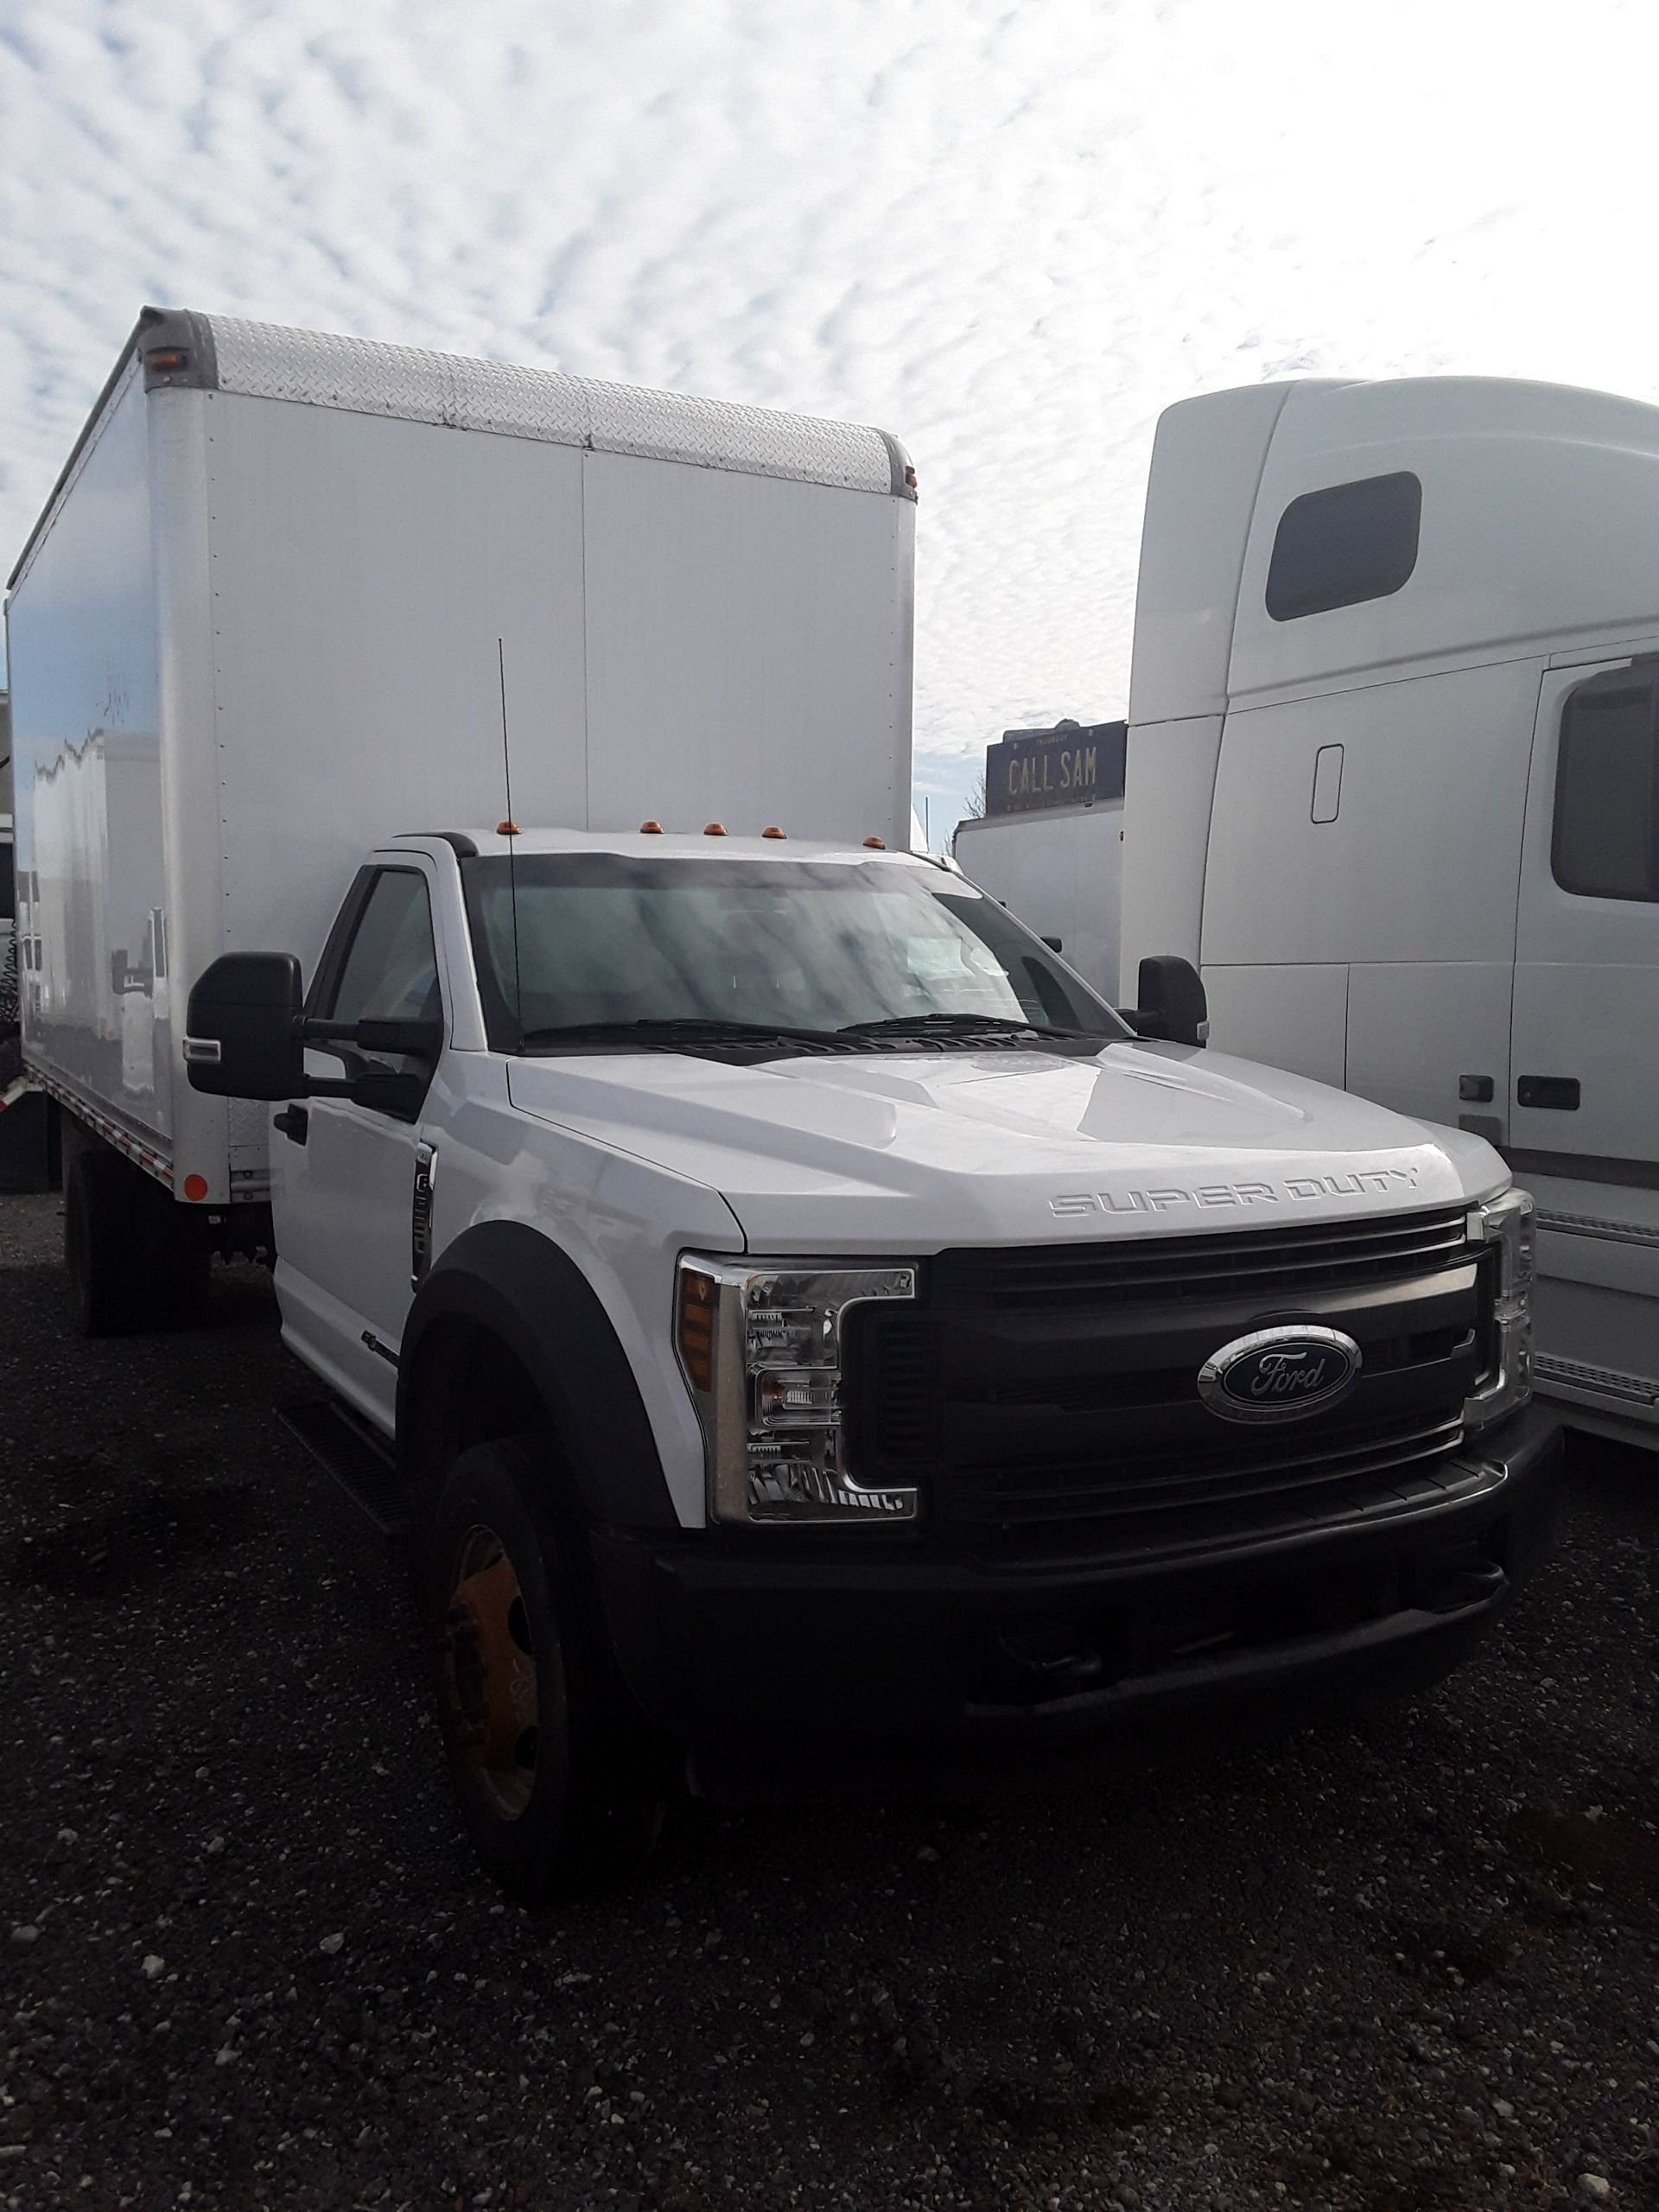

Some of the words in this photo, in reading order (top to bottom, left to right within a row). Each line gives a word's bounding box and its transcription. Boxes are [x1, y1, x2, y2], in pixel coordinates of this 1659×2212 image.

[1009, 755, 1053, 794] CALL
[1060, 747, 1096, 787] SAM
[1049, 1182, 1279, 1217] SUPER
[1282, 1166, 1420, 1201] DUTY
[1251, 1351, 1325, 1395] Ford
